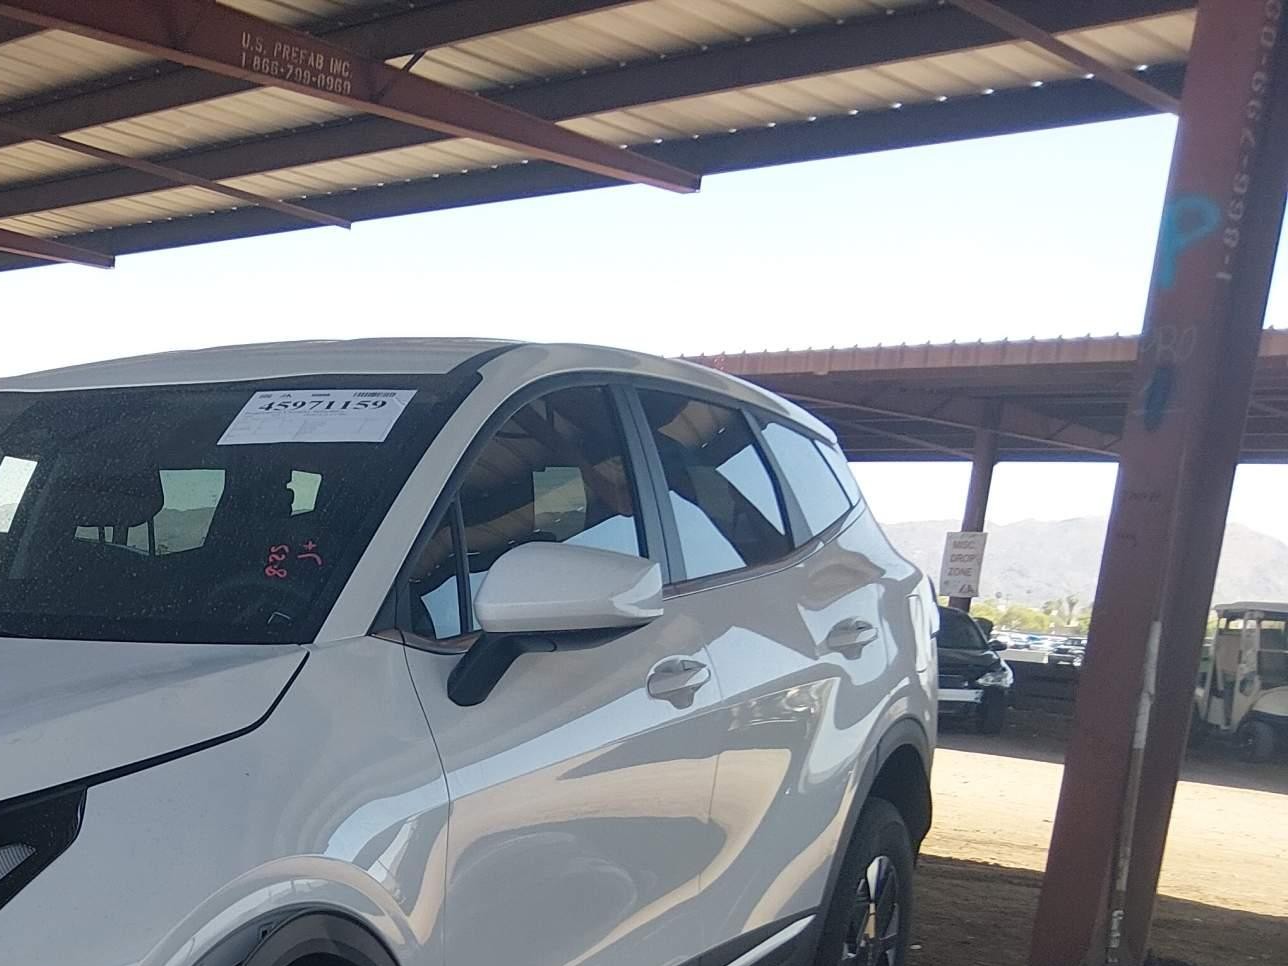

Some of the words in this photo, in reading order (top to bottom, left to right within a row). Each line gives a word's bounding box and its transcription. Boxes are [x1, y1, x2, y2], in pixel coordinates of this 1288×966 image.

[242, 32, 266, 55] U.S.
[274, 42, 325, 70] PREFAB
[258, 400, 387, 412] 45971159
[950, 553, 977, 563] DROP
[947, 567, 973, 577] ZONE
